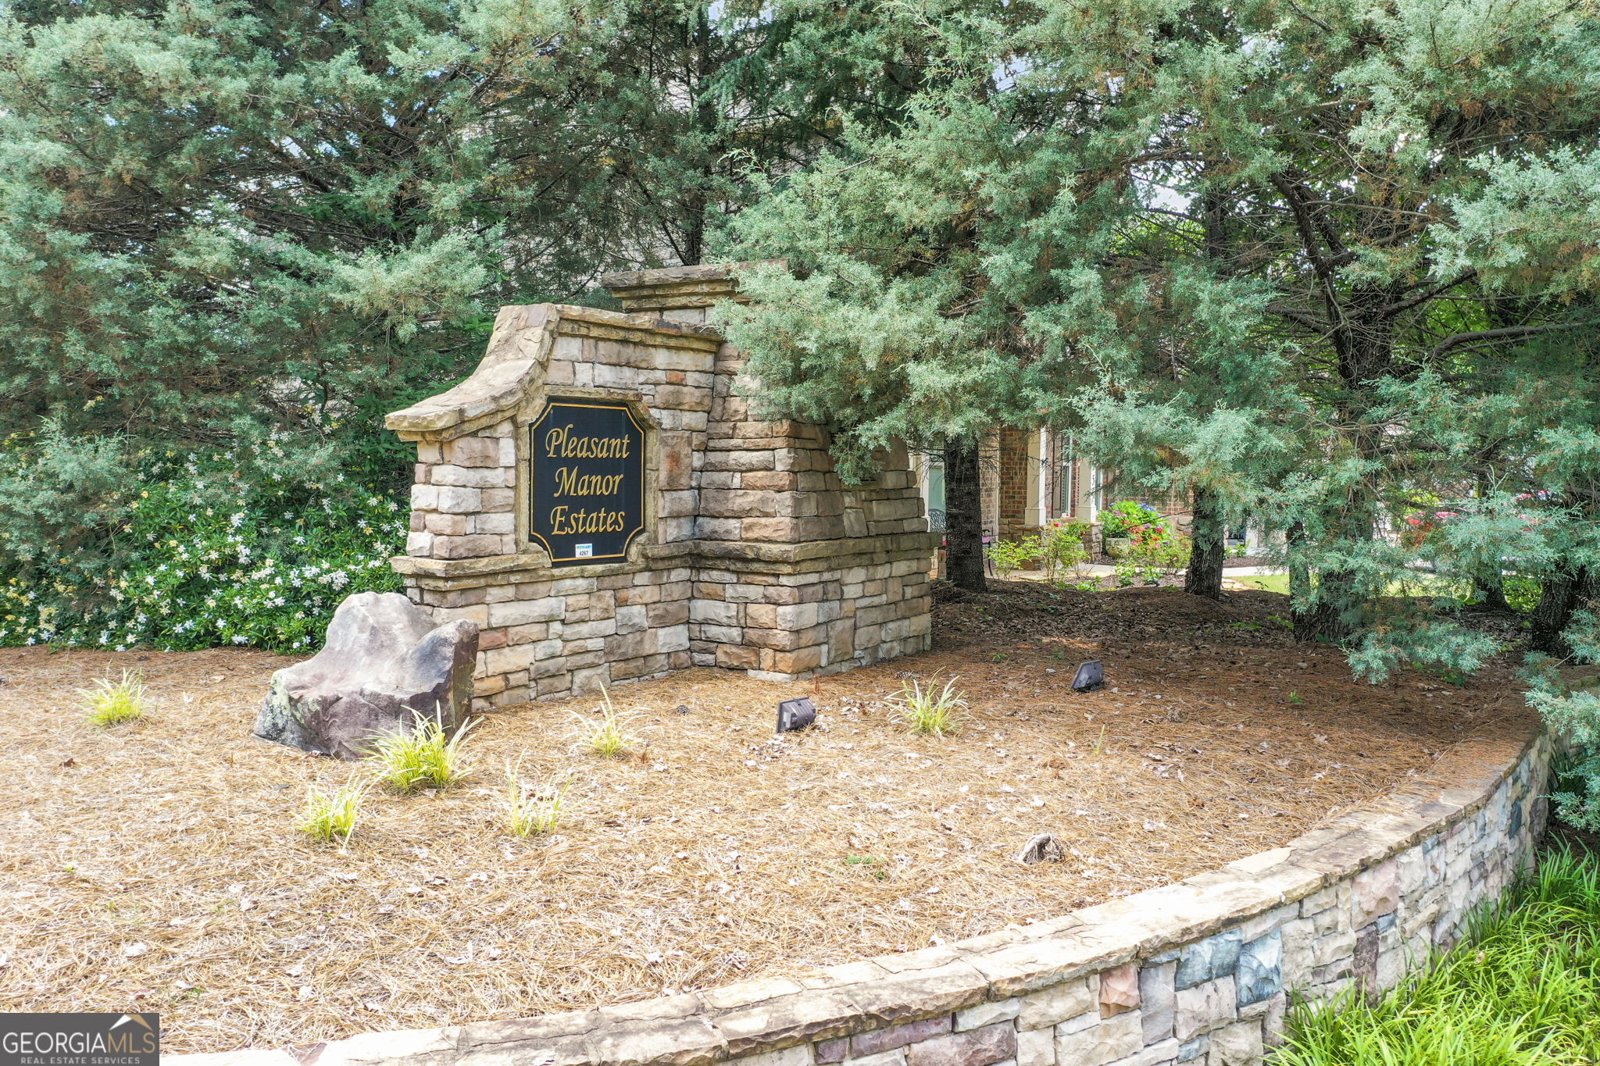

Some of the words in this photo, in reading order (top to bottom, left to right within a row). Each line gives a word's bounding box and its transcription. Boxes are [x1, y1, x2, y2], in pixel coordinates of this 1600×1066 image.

[545, 423, 630, 459] Pleasant
[553, 465, 624, 498] Manor
[550, 505, 626, 535] Estates
